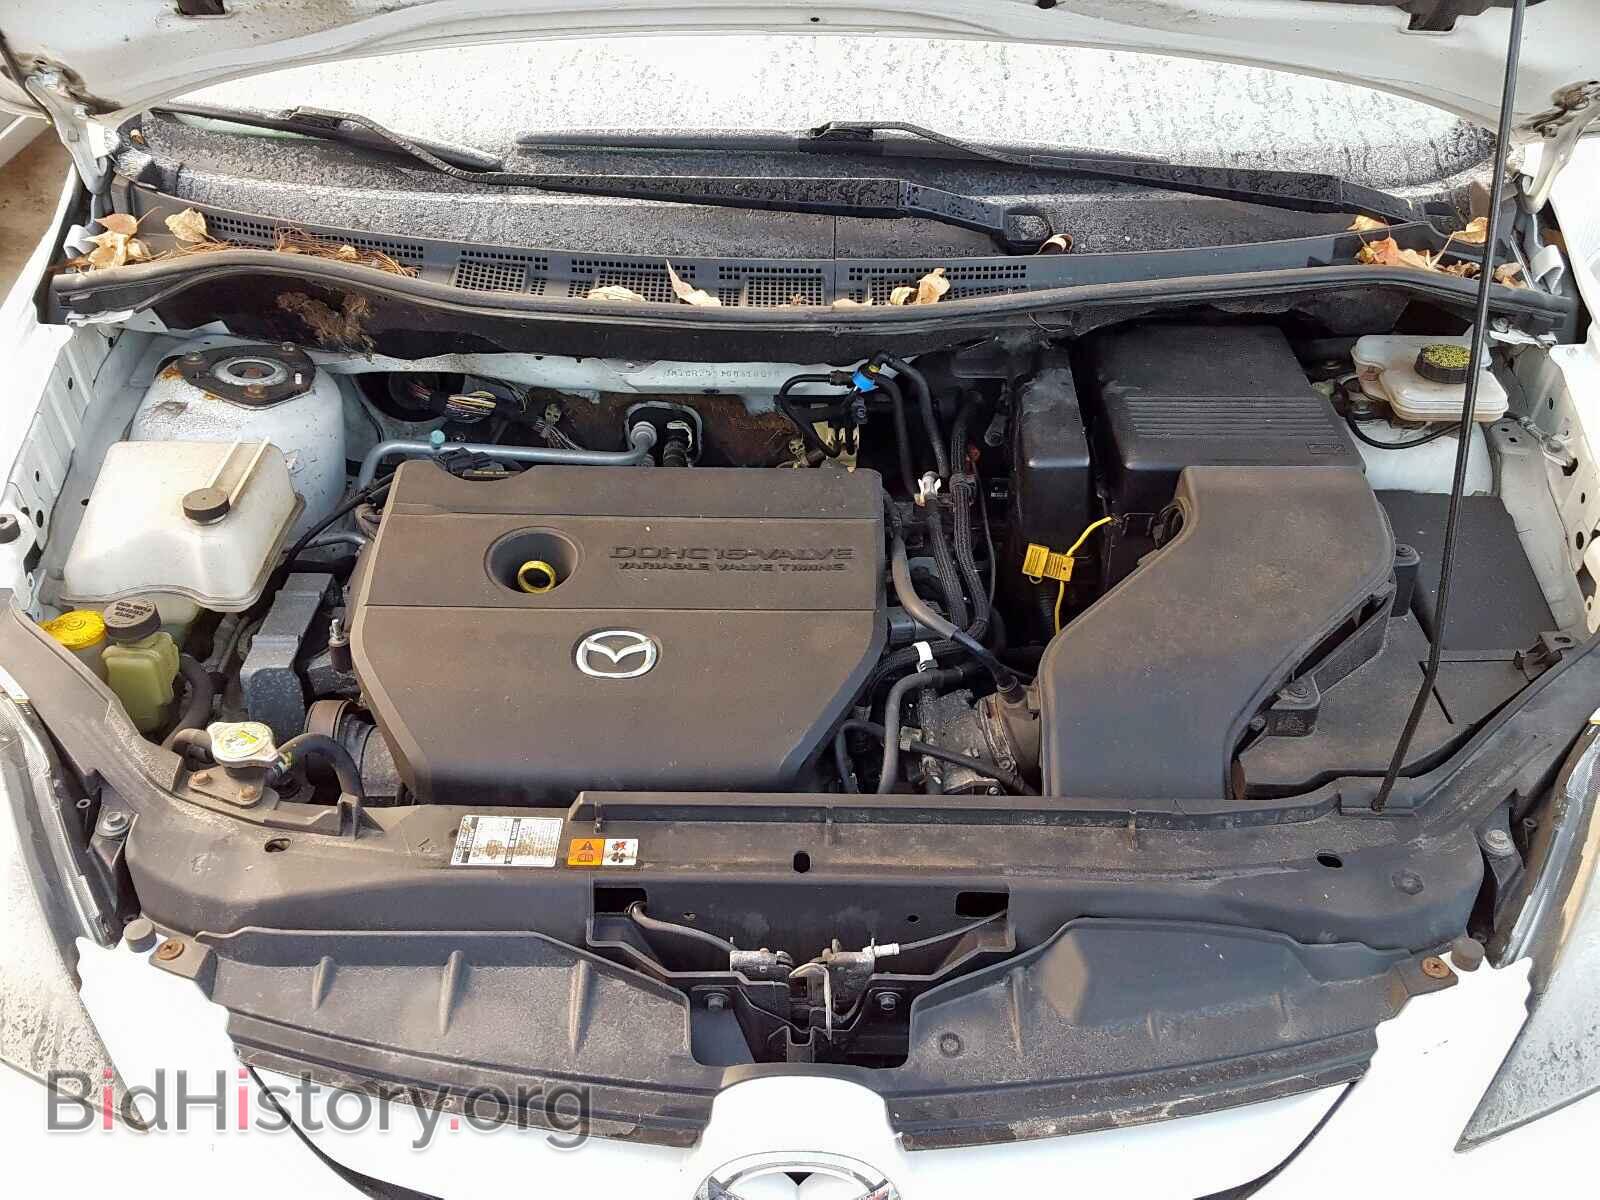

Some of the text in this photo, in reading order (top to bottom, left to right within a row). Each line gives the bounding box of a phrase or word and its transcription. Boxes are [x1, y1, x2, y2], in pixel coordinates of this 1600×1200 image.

[609, 546, 709, 560] DOHC
[618, 562, 710, 572] VARIABLE
[717, 562, 774, 573] VALVE
